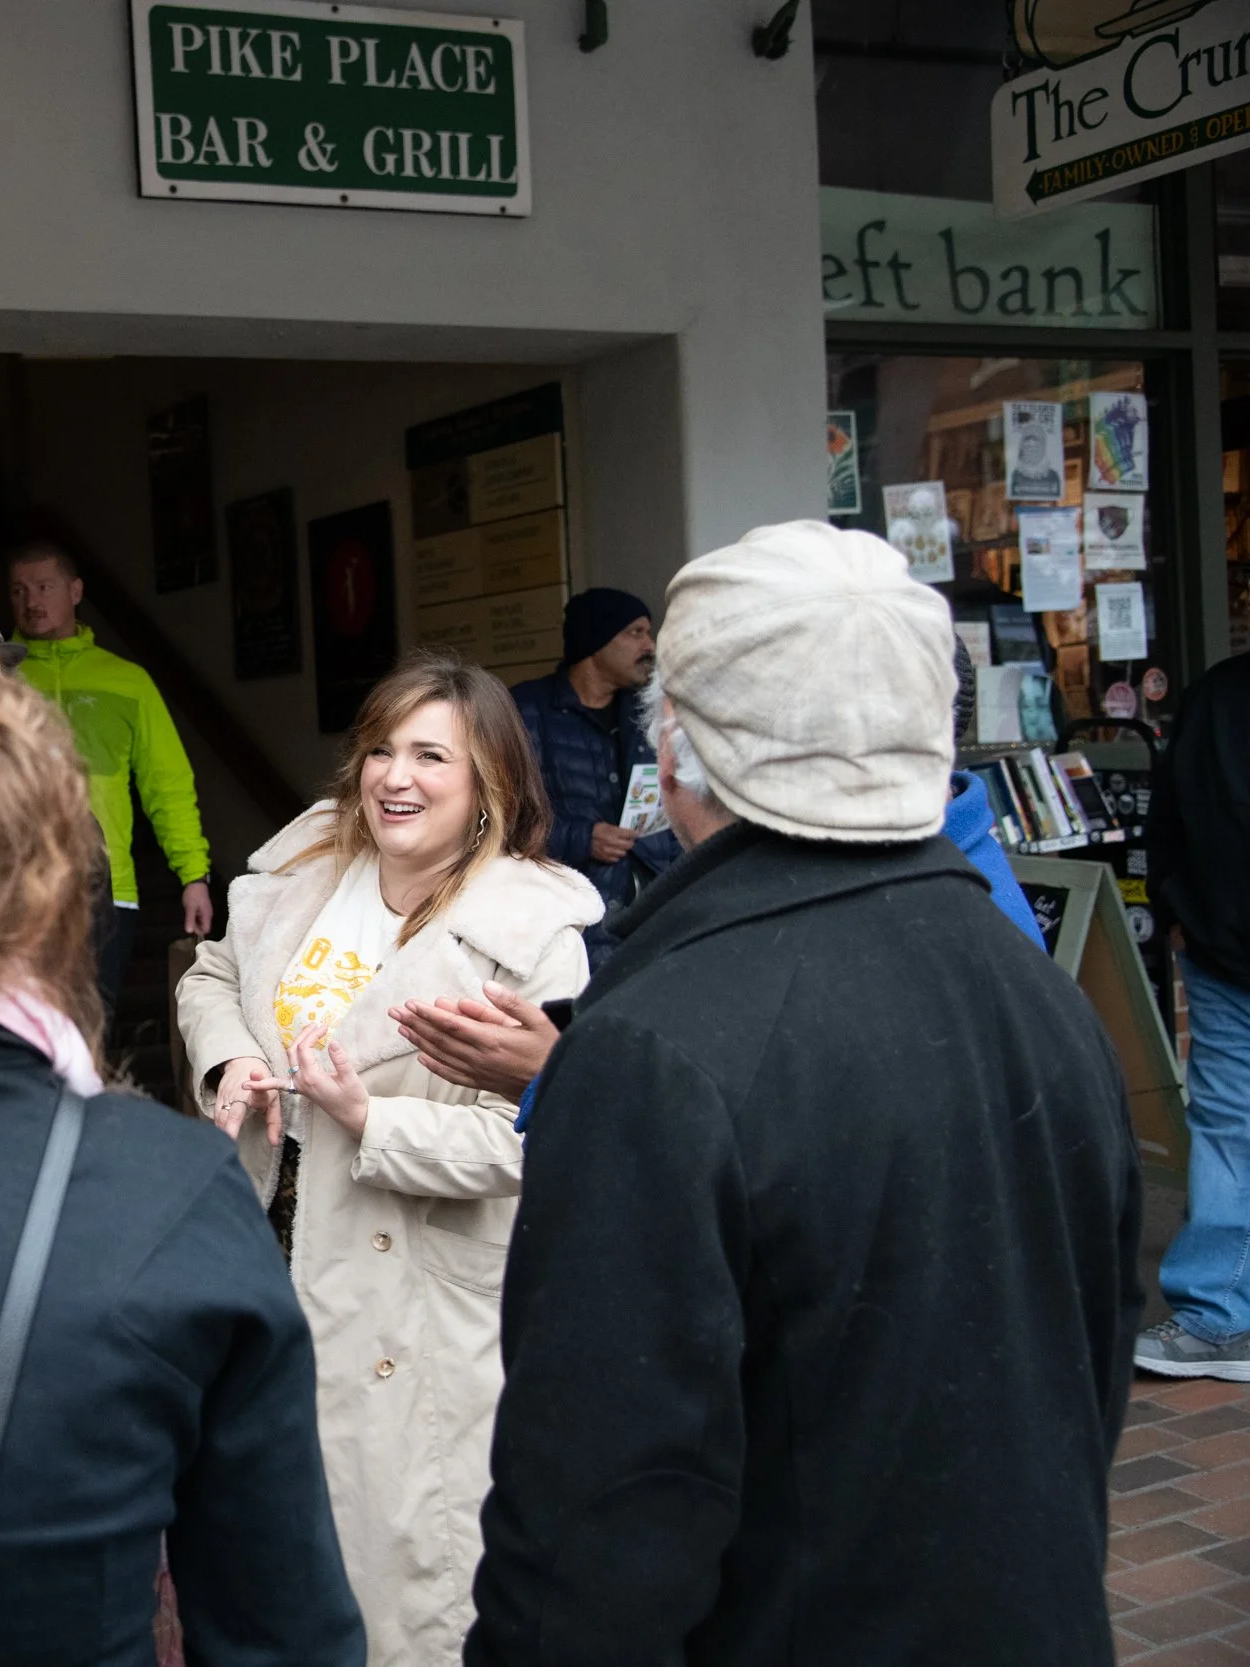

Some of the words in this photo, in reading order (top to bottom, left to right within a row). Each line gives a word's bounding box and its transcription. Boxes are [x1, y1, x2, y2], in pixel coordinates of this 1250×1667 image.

[167, 22, 302, 81] PIKE
[326, 35, 496, 94] PLACE
[155, 112, 273, 168] BAR
[298, 122, 338, 173] &
[363, 125, 517, 184] GRILL
[1012, 79, 1109, 164] The
[938, 227, 1149, 317] bank
